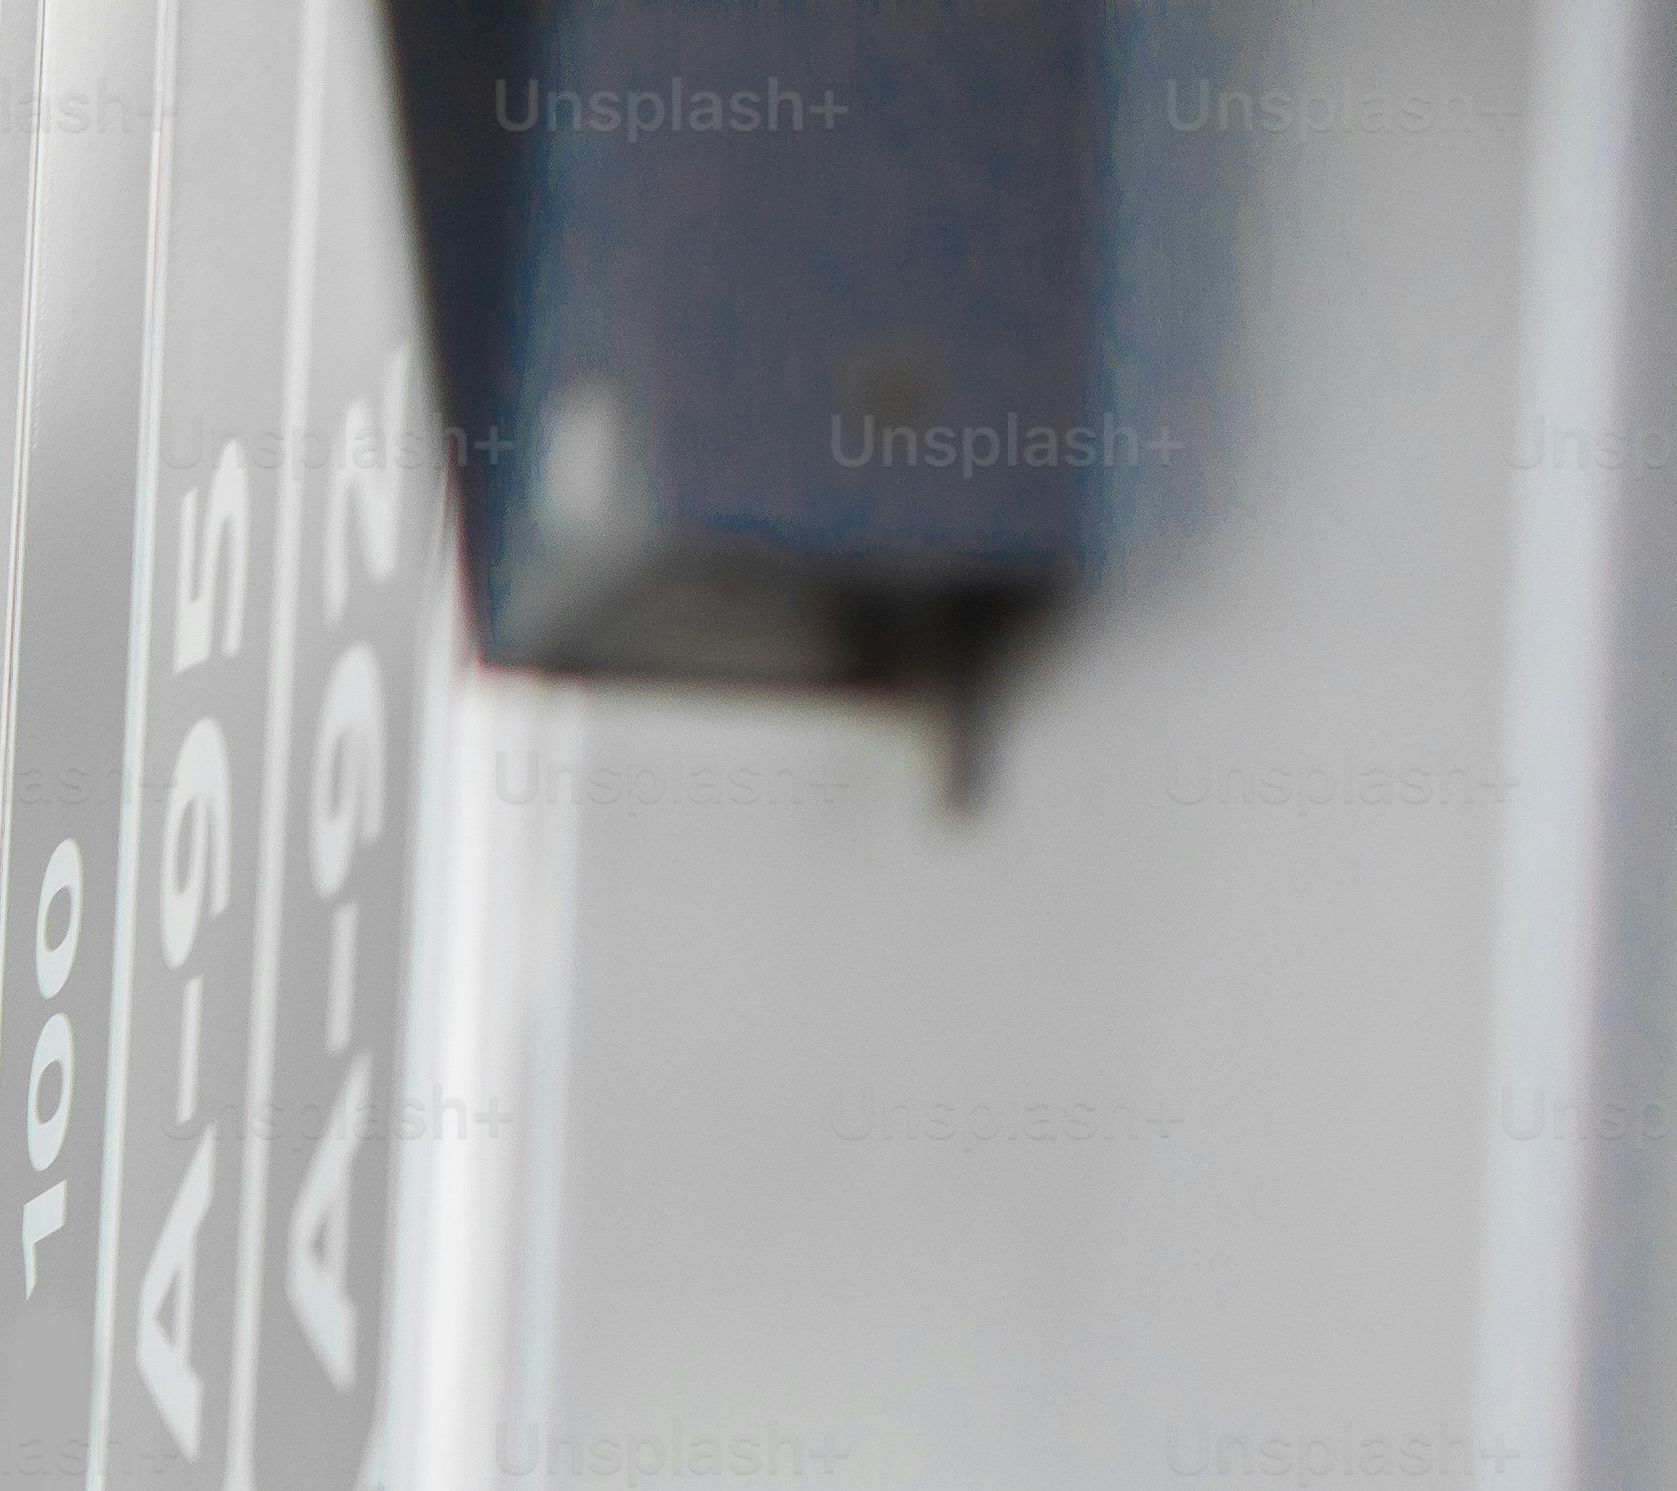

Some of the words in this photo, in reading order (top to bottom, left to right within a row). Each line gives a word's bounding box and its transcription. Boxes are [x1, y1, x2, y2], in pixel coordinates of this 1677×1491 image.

[22, 838, 84, 1301] 100
[135, 438, 249, 1465] A-95
[284, 343, 413, 1396] A-92
